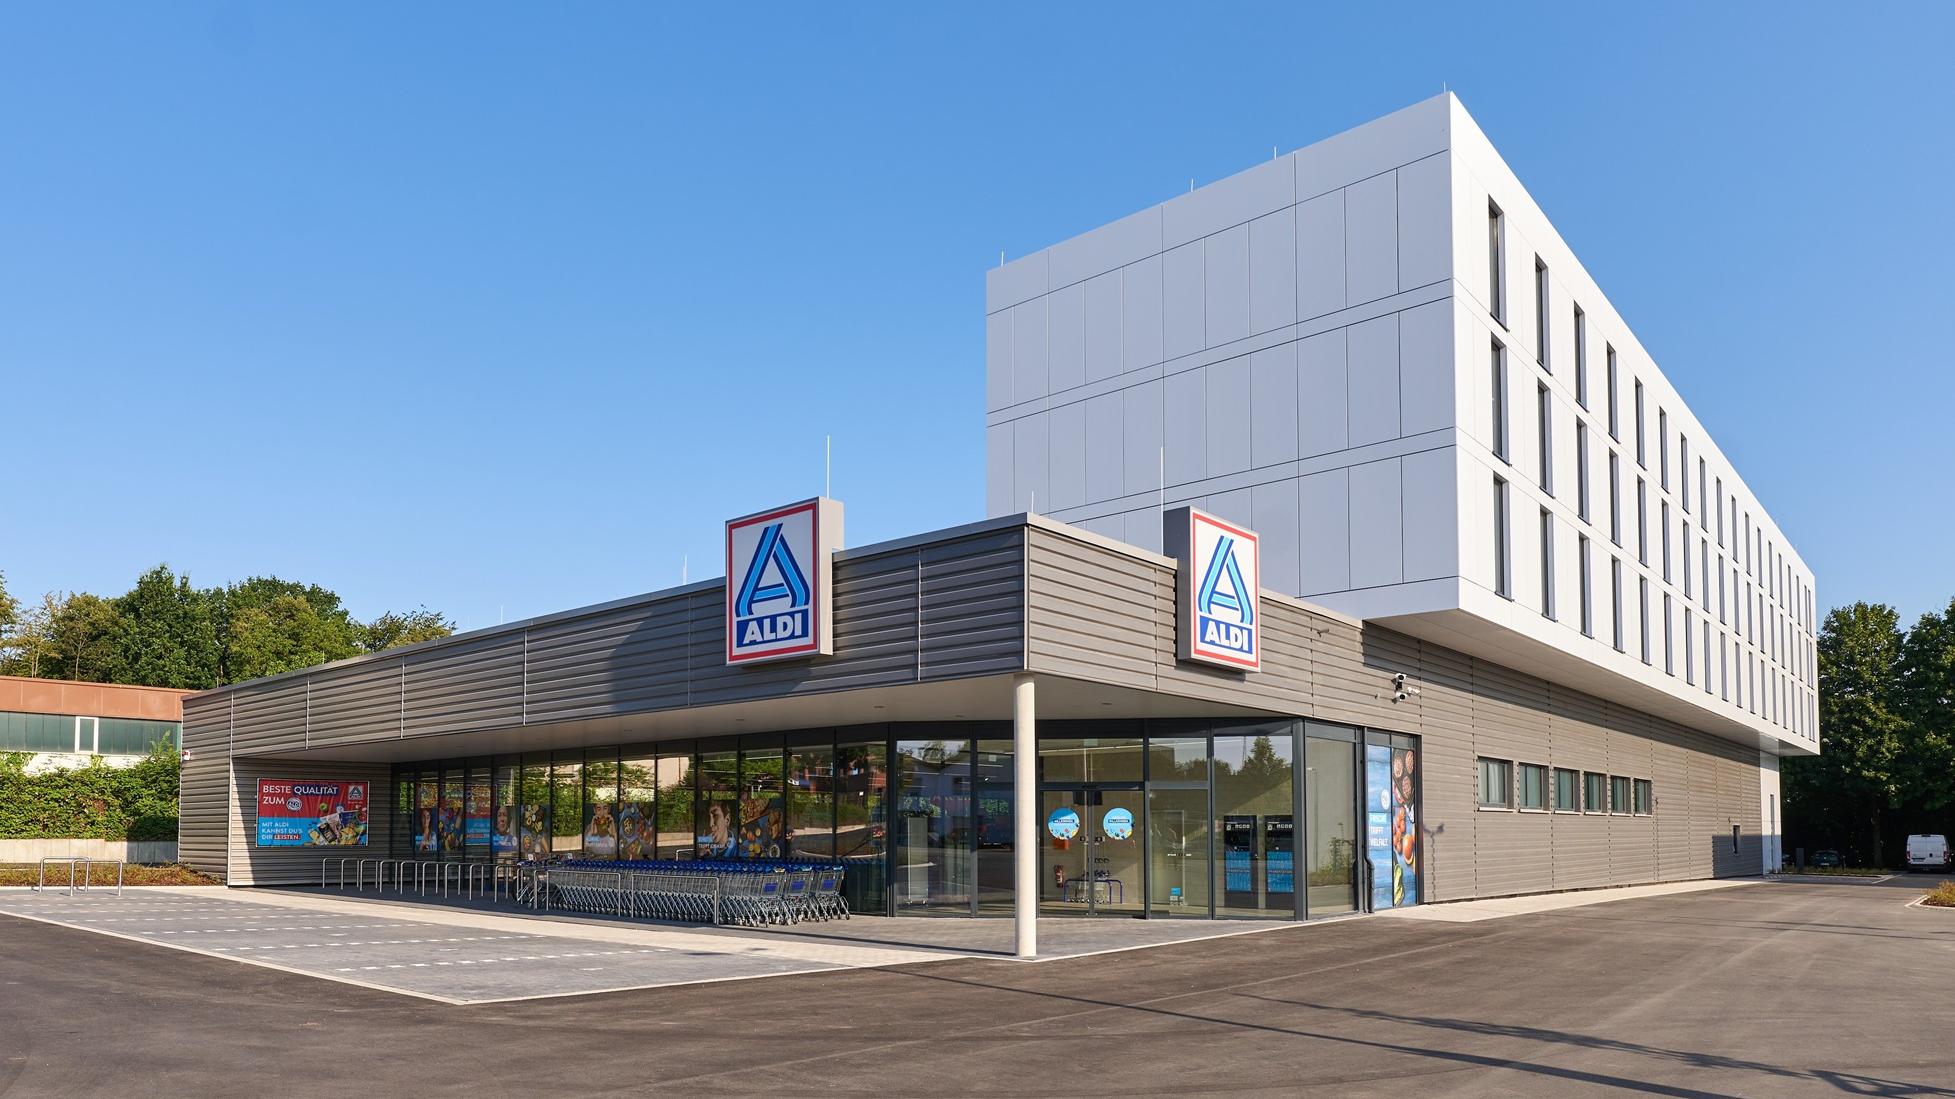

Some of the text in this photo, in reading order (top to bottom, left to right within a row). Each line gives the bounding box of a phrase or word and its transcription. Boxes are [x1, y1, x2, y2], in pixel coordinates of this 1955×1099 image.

[742, 612, 803, 645] ALDI
[1204, 620, 1250, 652] ALDI
[262, 785, 338, 795] BESTE QUALITÄT
[262, 796, 285, 805] ZUM
